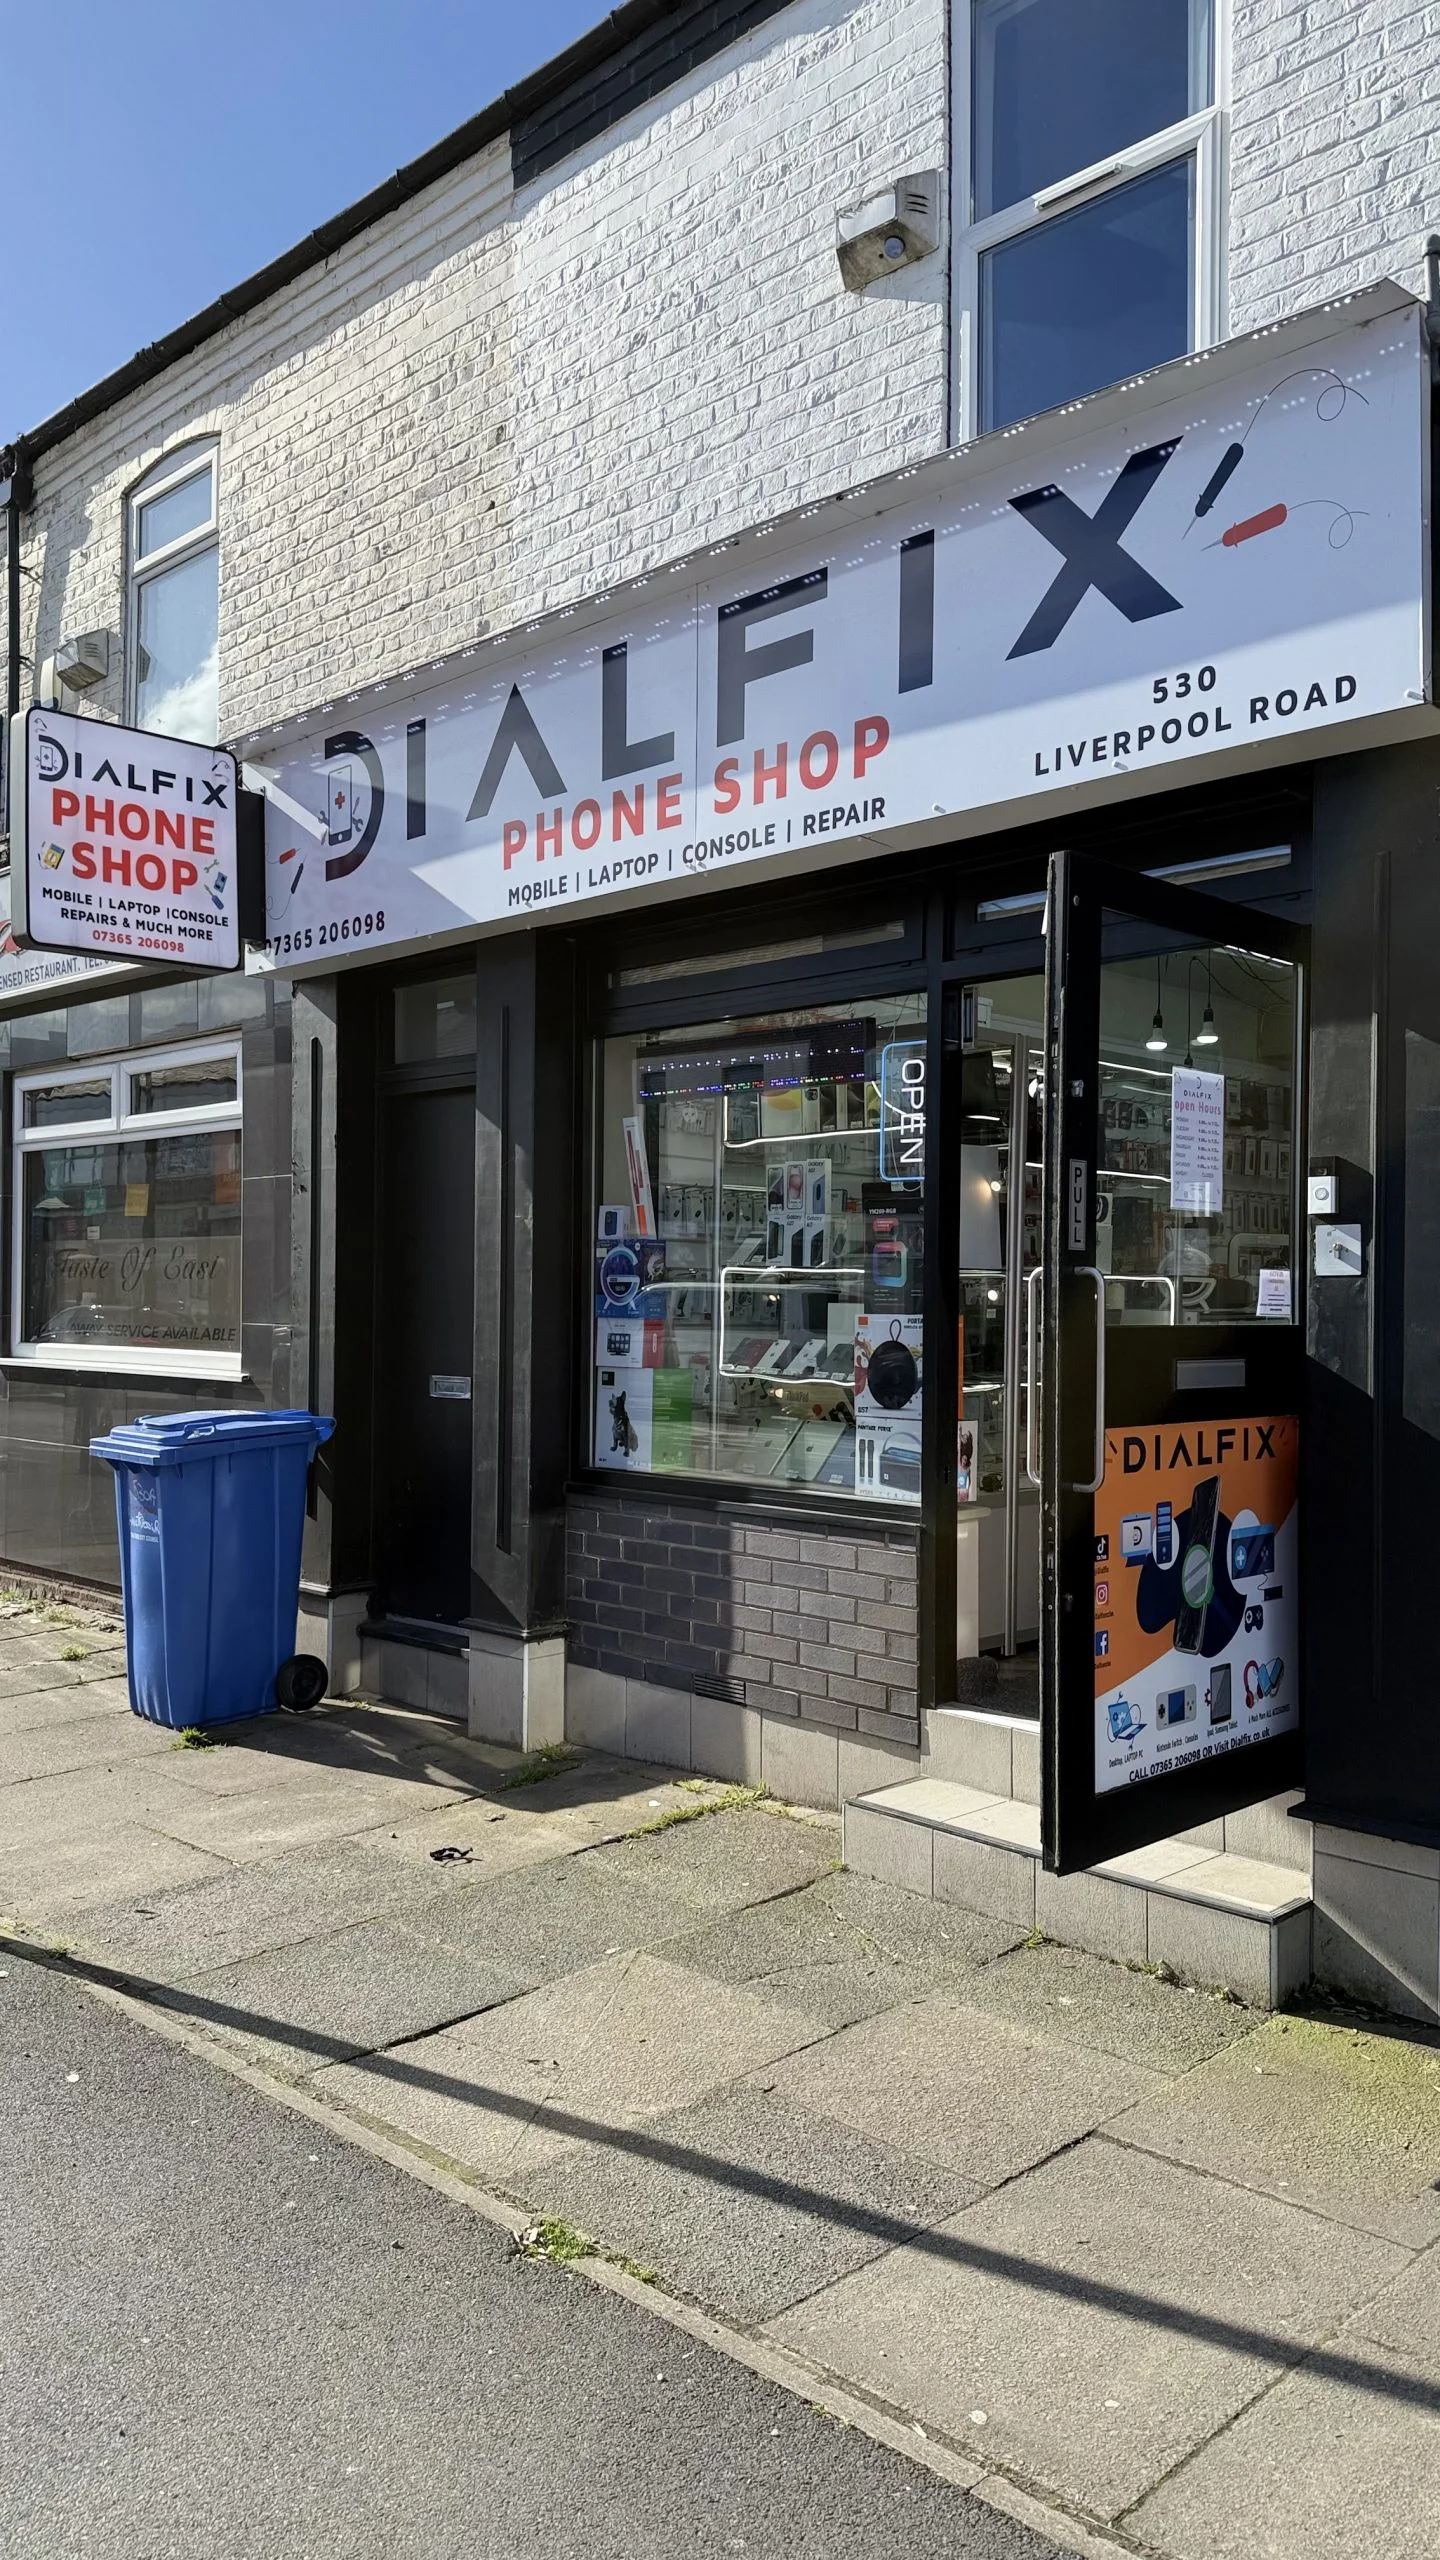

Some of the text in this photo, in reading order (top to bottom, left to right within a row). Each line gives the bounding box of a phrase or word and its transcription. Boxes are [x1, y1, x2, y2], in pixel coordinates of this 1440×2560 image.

[325, 436, 1184, 882] DIALFIX
[1153, 666, 1216, 704] 530
[1035, 675, 1357, 776] LIVERPOOL ROAD
[39, 735, 228, 809] DIALFIX
[503, 716, 891, 871] PHONE SHOP
[53, 788, 215, 855] PHONE
[72, 842, 198, 895] SHOP
[508, 874, 568, 906] MOBILE
[588, 853, 659, 887] LAPTOP
[682, 823, 776, 866] CONSOLE
[803, 797, 886, 836] REPAIR
[43, 887, 92, 905] MOBILE
[109, 898, 160, 916] LAPTOP
[61, 908, 213, 941] REPAIRS & MUCH MORE
[92, 930, 184, 952] 07365 206098
[319, 911, 385, 945] 206098
[901, 1059, 925, 1163] OPEN
[1175, 1101, 1221, 1115] open Hours
[1184, 1090, 1211, 1100] DIALFIX
[1074, 1167, 1083, 1243] PULL
[54, 1246, 220, 1292] Taste Of East
[107, 1324, 159, 1338] SERVICE
[162, 1327, 236, 1341] AVAILABLE
[1123, 1425, 1276, 1474] DIALFIX
[1129, 1766, 1149, 1782] CALL
[1150, 1758, 1173, 1775] 07365
[1174, 1749, 1201, 1767] 206098
[1202, 1745, 1213, 1758] OR
[1214, 1738, 1229, 1753] Visit
